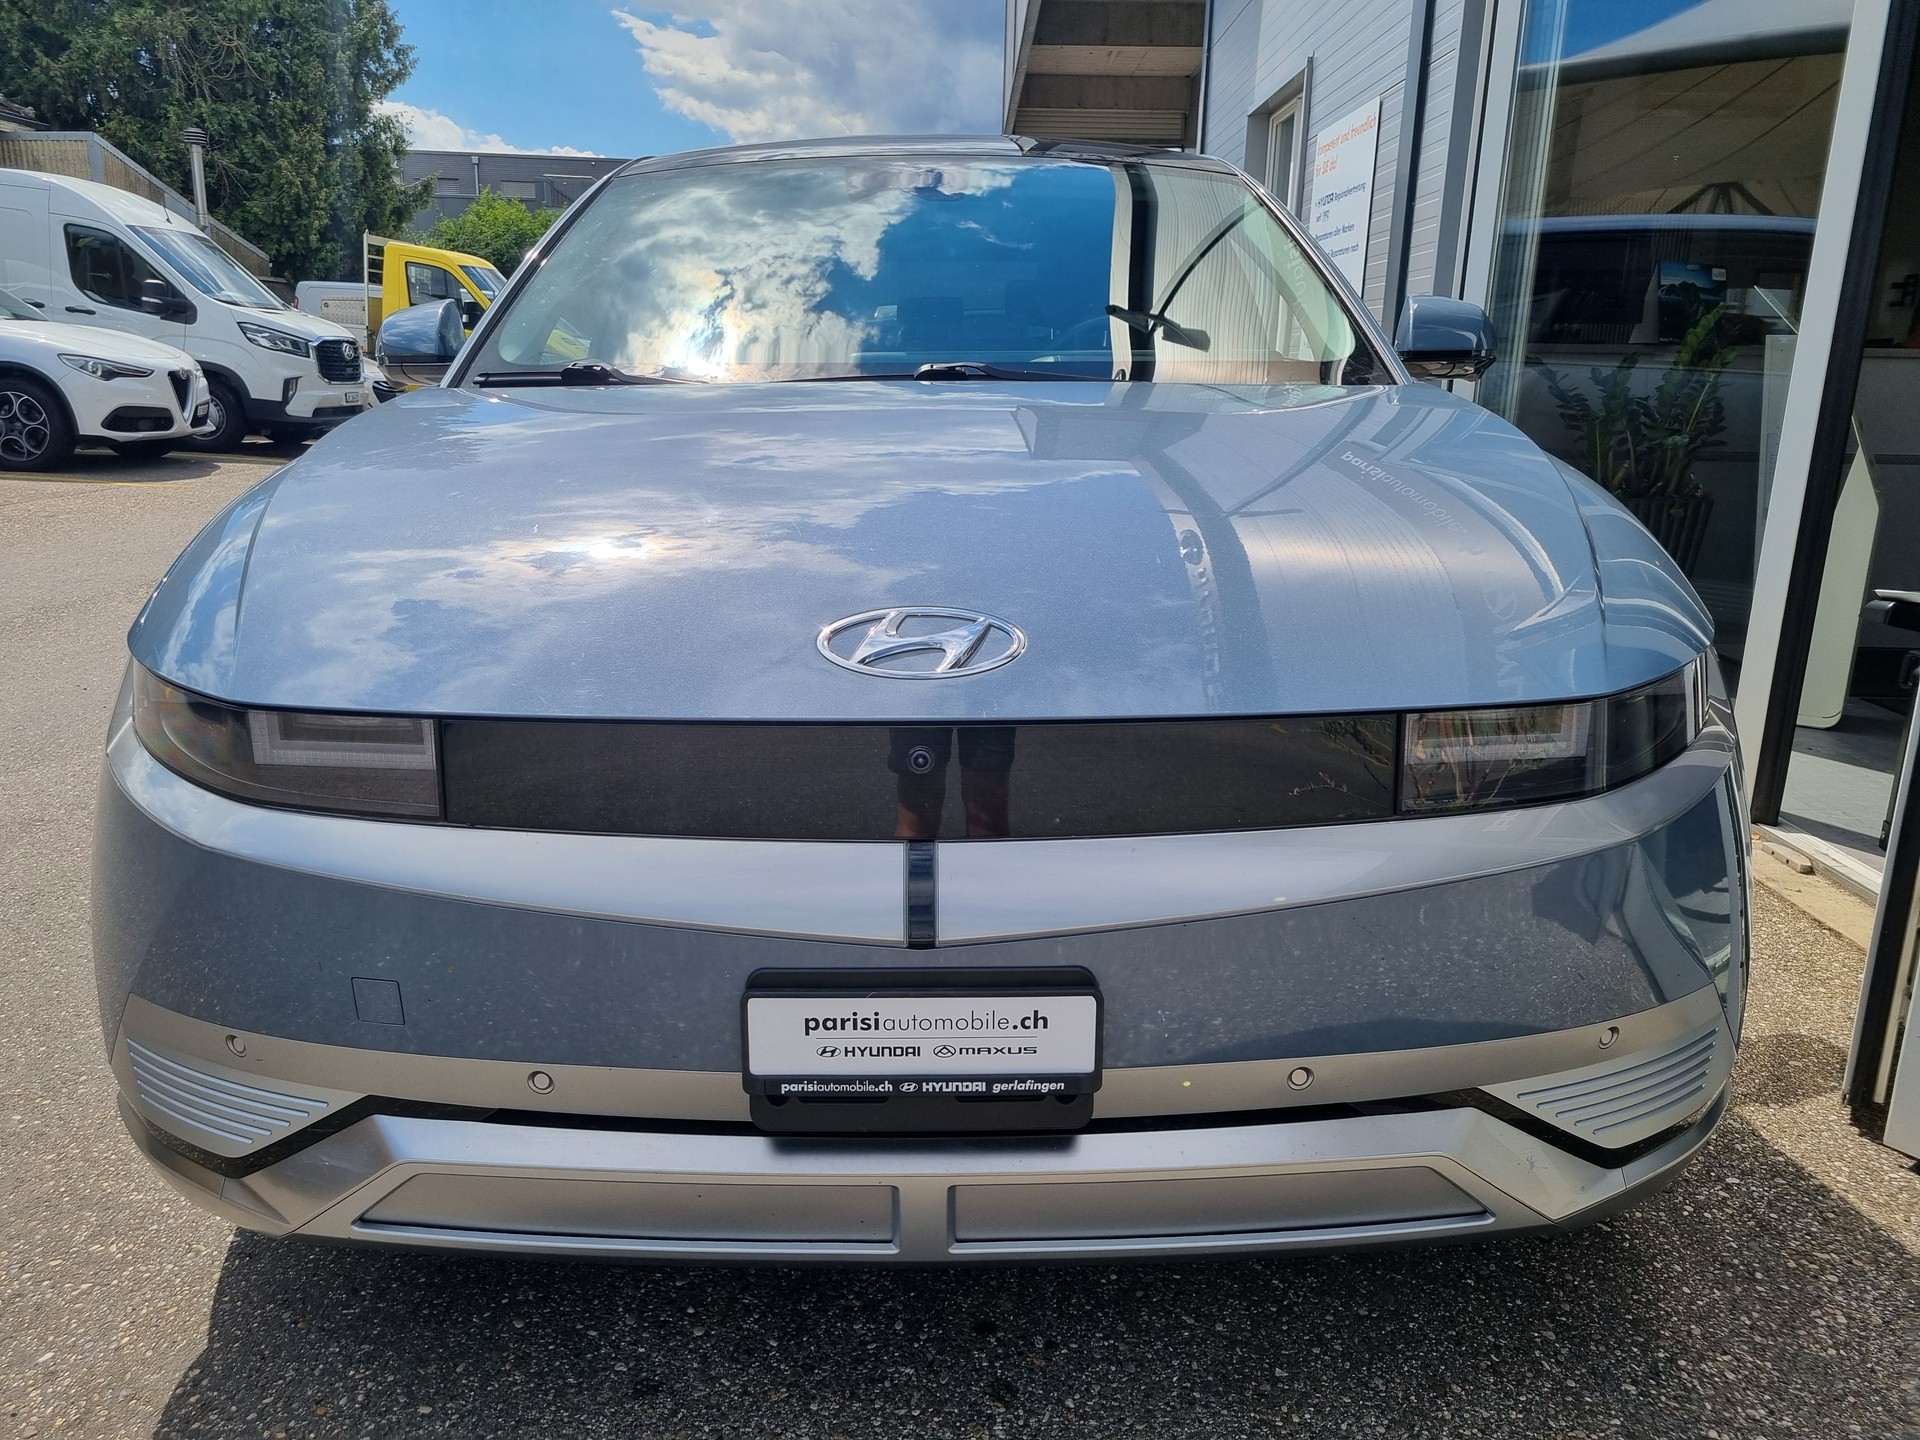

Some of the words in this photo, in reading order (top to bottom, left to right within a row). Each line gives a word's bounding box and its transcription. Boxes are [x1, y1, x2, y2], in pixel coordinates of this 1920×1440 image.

[804, 1010, 1049, 1036] parisiautomobile.ch
[844, 1046, 921, 1058] HYUNDAI
[781, 1080, 893, 1095] parisiautomobile.ch
[922, 1081, 986, 1092] HYUNDAI
[992, 1080, 1065, 1095] gerlafingen
